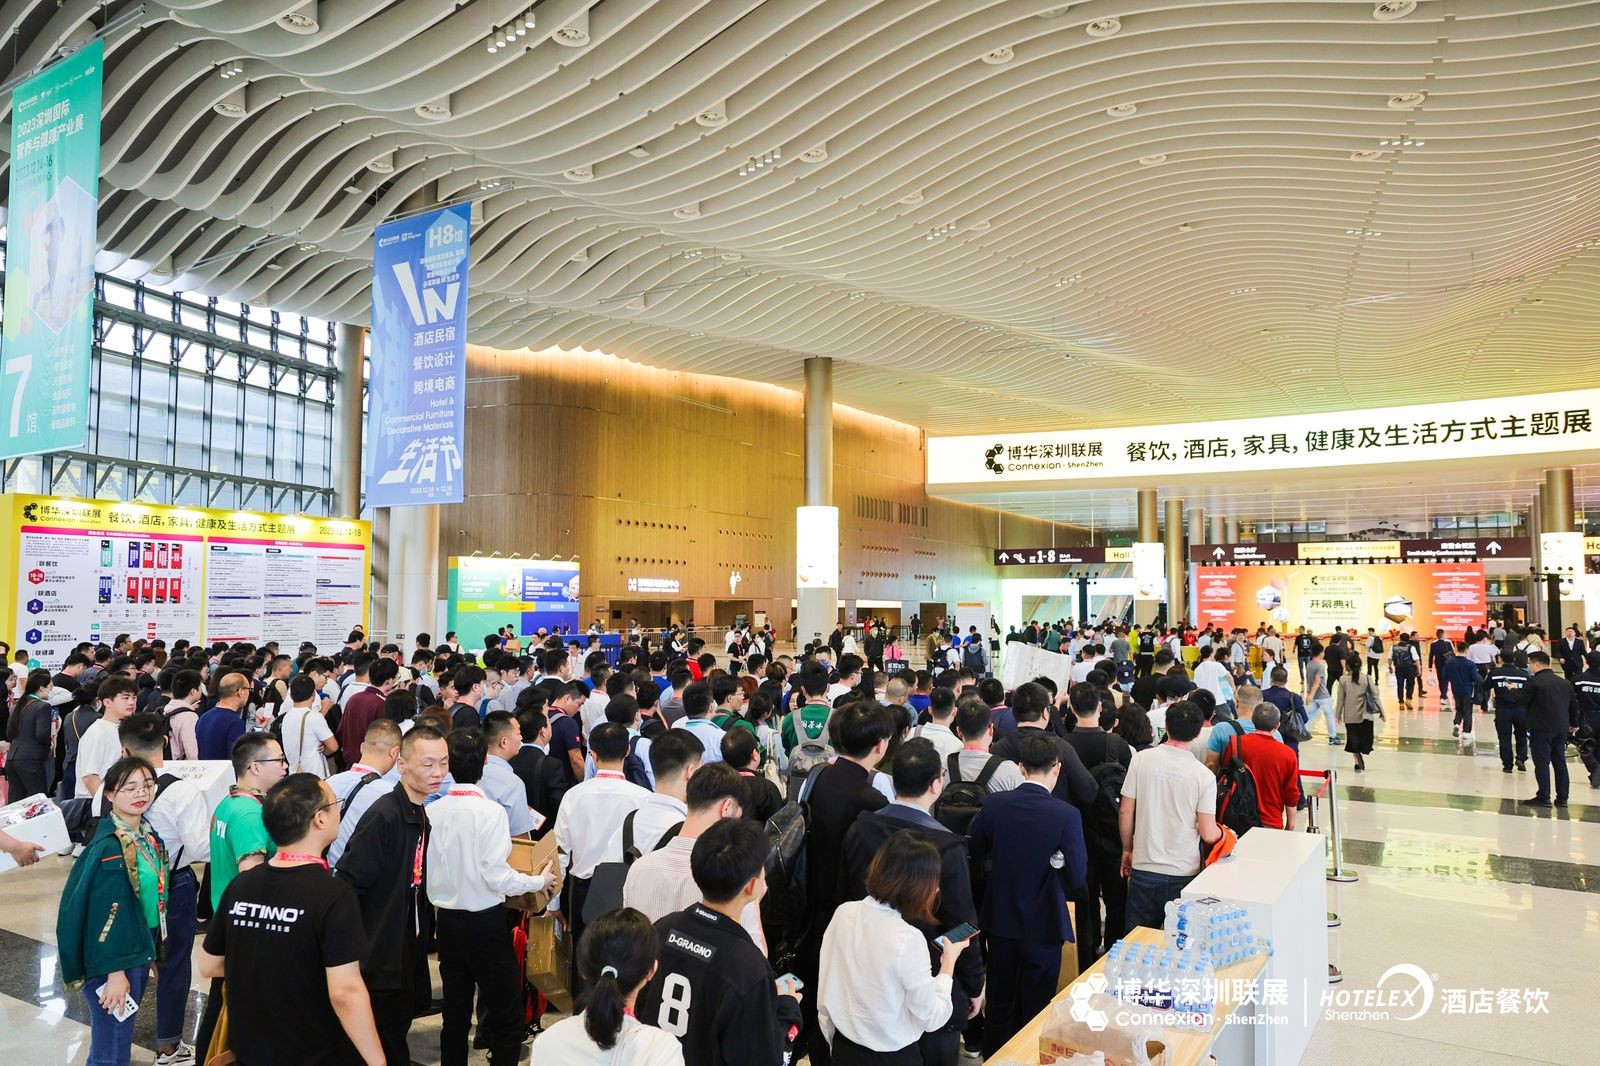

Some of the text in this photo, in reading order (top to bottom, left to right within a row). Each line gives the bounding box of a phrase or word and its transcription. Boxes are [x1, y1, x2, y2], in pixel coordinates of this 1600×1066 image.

[17, 99, 71, 138] 2023深圳国际
[16, 113, 84, 161] 营养与健康产业展
[414, 326, 456, 347] 酒店民宿
[413, 350, 455, 371] 餐饮设计
[413, 375, 455, 395] 跨境电商
[430, 396, 455, 408] Hotel &
[385, 409, 454, 425] Commercial Furniture
[387, 420, 454, 435] Decorative Materials
[377, 435, 462, 485] 生活节
[1007, 441, 1104, 461] 博华深圳联展
[1007, 459, 1104, 472] Connexion ShenZhen
[40, 504, 102, 519] 博华深圳联展
[40, 515, 76, 523] Connexion
[1036, 549, 1056, 563] 1-8
[1310, 599, 1356, 609] 开幕典礼
[229, 901, 298, 923] JETINNO
[695, 907, 718, 921] D-GRAGNO
[668, 933, 712, 958] D-GRAGNO
[657, 972, 692, 1038] 8
